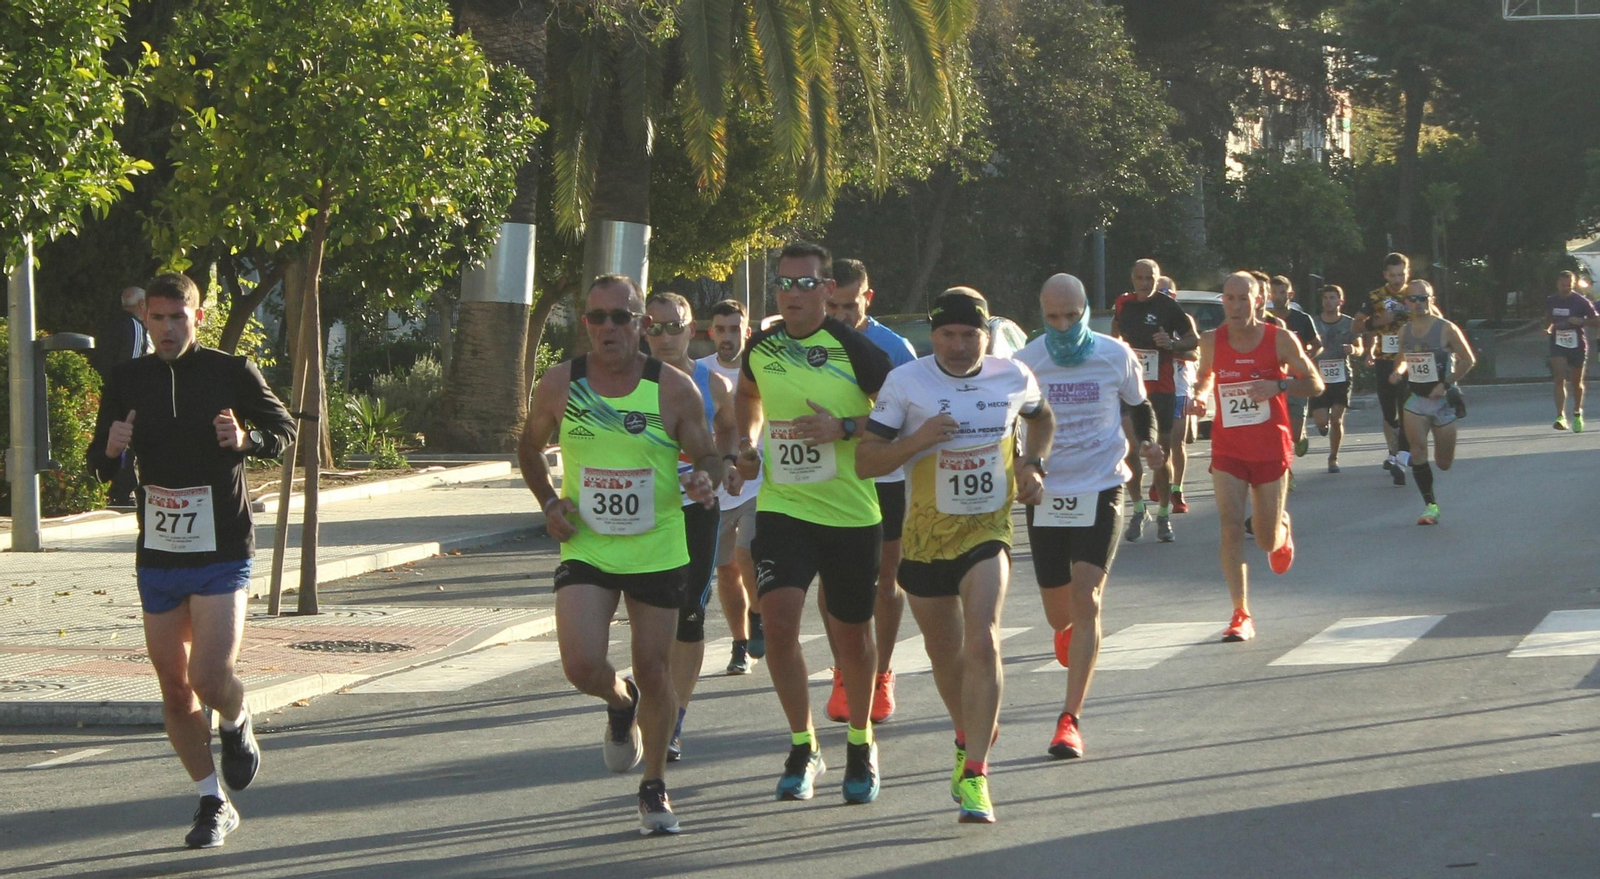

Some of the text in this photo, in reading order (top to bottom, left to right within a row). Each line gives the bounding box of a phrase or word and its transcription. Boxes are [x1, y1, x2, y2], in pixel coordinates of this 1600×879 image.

[1323, 367, 1340, 377] 382
[1411, 363, 1430, 375] 148
[1048, 382, 1075, 393] XXIV
[1229, 398, 1259, 414] 244
[778, 443, 821, 465] 205
[948, 471, 994, 496] 198
[592, 492, 639, 516] 380
[1052, 497, 1078, 511] 59
[155, 510, 198, 534] 277
